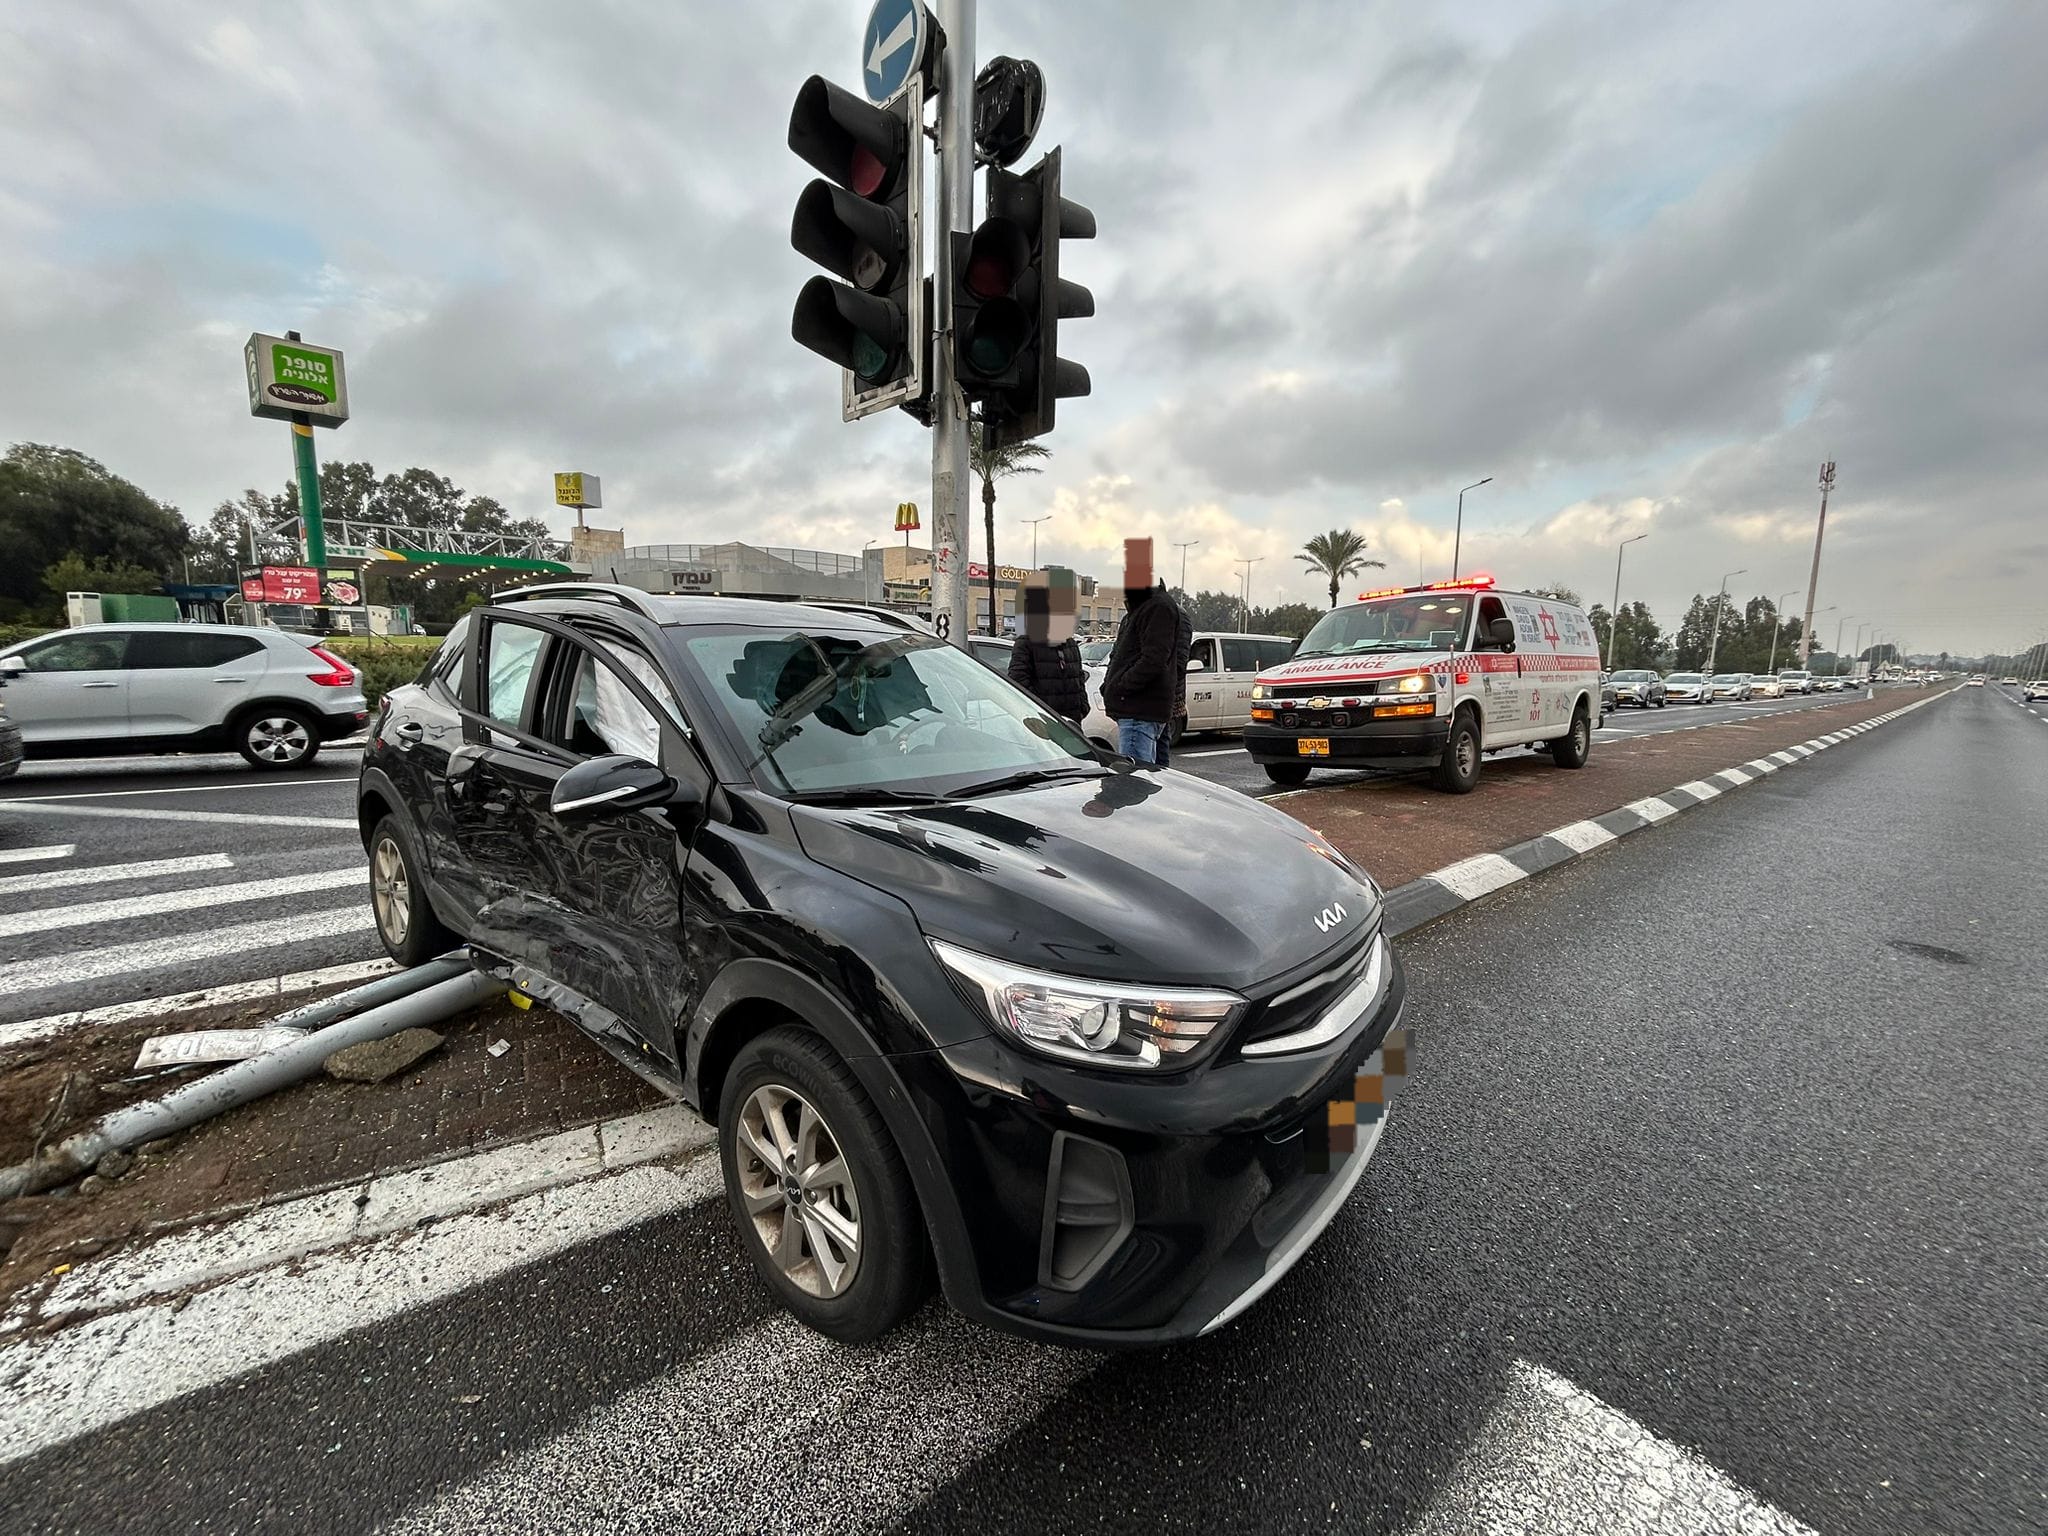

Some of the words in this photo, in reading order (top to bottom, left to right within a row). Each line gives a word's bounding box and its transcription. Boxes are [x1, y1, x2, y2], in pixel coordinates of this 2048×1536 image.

[281, 355, 327, 373] סופר
[282, 368, 328, 385] אלונית
[283, 587, 302, 600] 79
[935, 613, 950, 640] 8
[1280, 660, 1389, 675] AMBULANCE
[1530, 710, 1541, 721] 101
